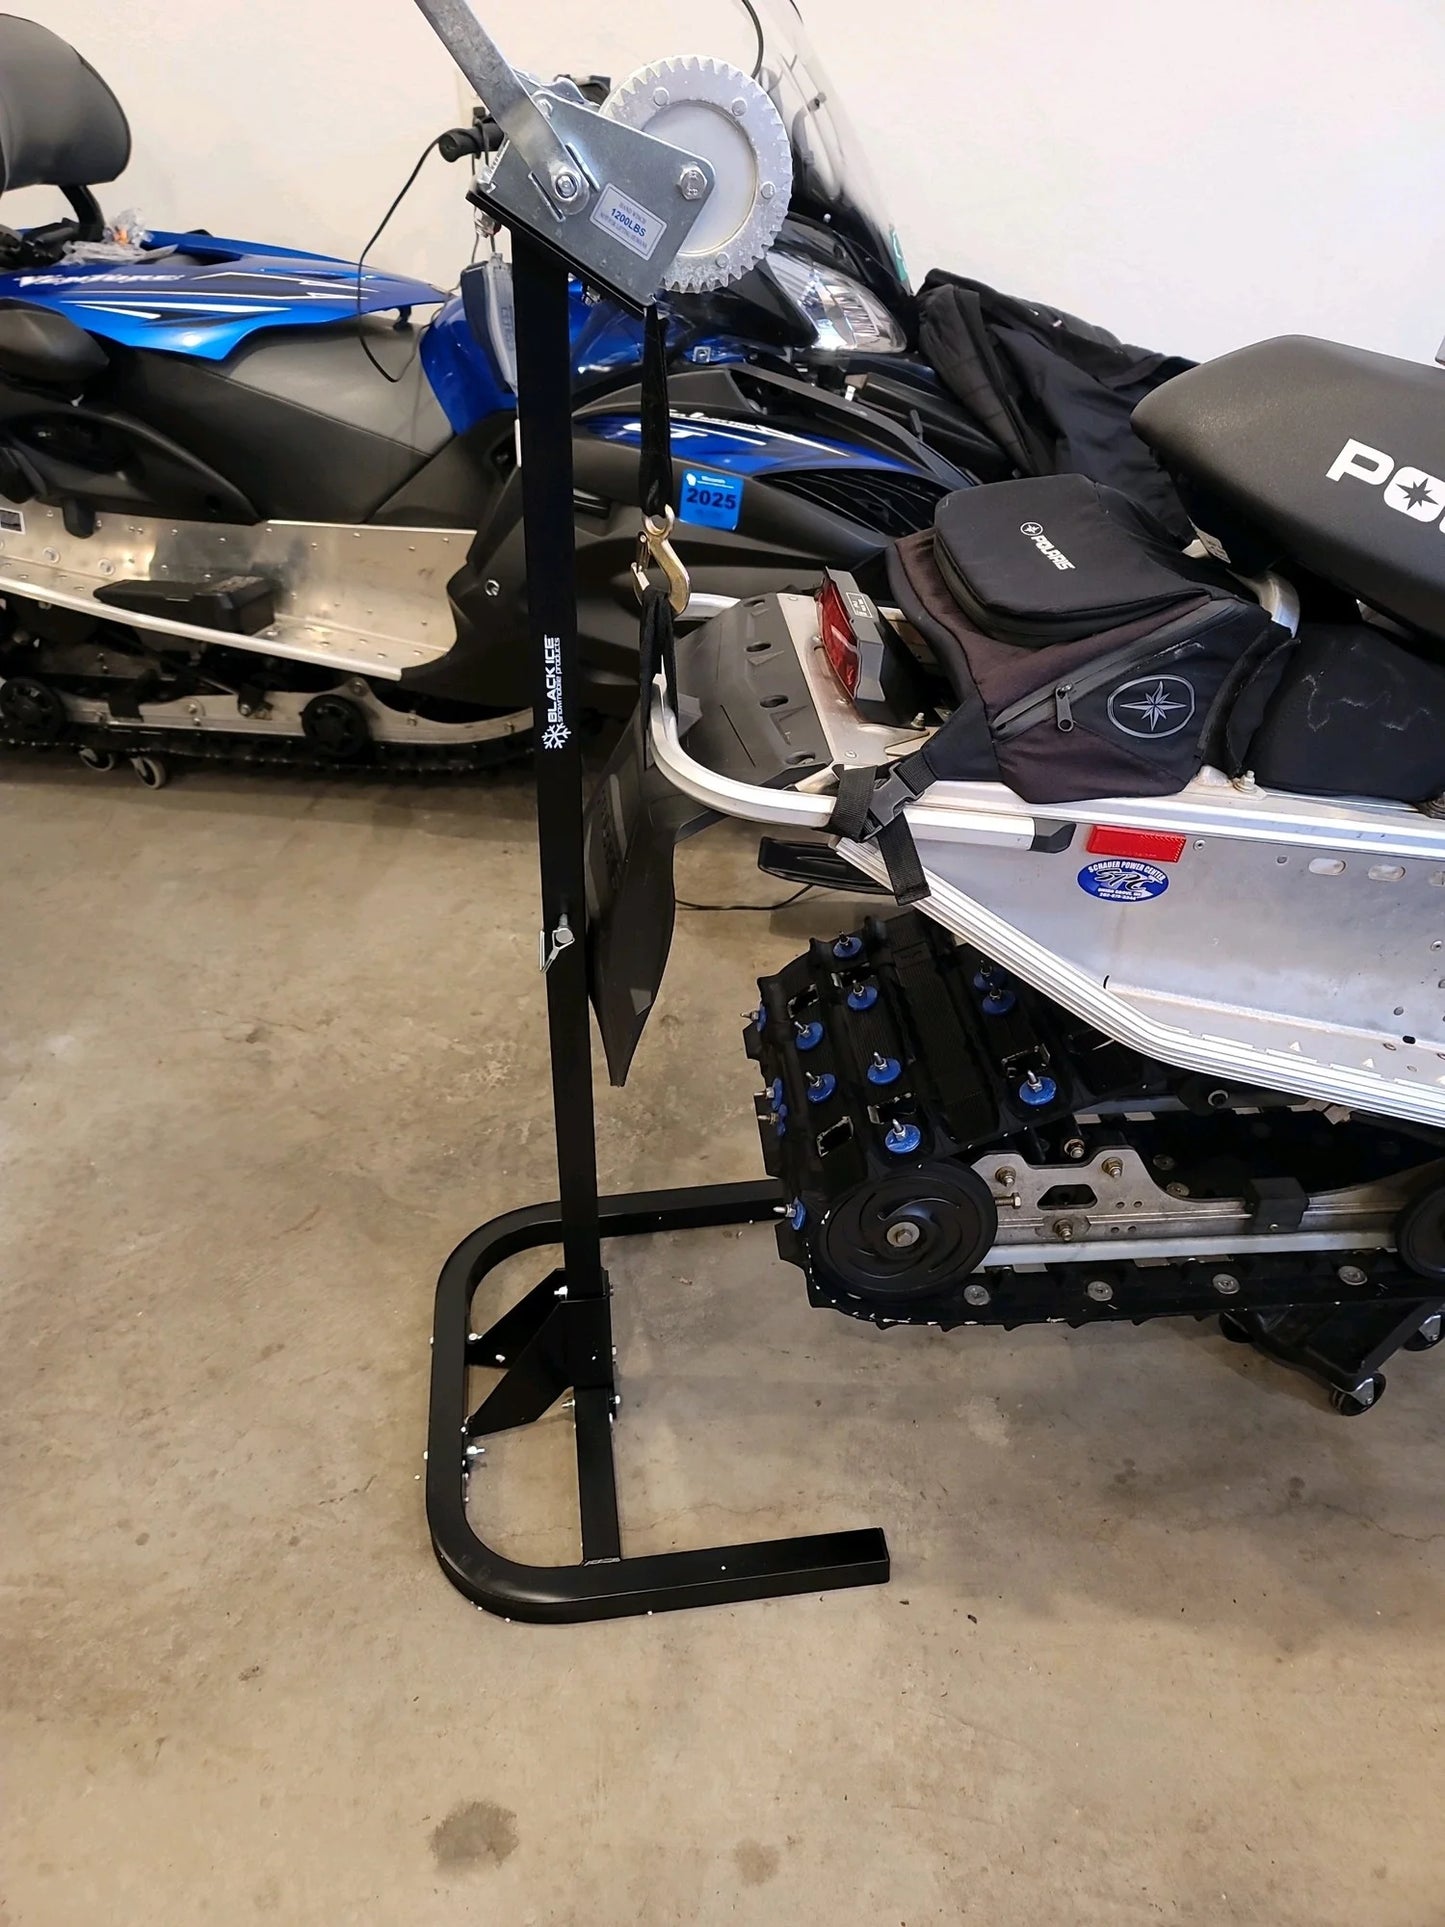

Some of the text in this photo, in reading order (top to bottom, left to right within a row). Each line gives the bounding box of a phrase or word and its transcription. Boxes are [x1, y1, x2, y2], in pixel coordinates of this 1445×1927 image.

[611, 208, 647, 237] 1200LBS
[686, 487, 737, 510] 2025
[1325, 438, 1445, 534] PO
[1030, 535, 1076, 570] POLARIS
[544, 637, 558, 723] BLACK ICE
[554, 637, 564, 723] snowmobile products
[1088, 861, 1167, 881] SCHAUER POWER CENTER
